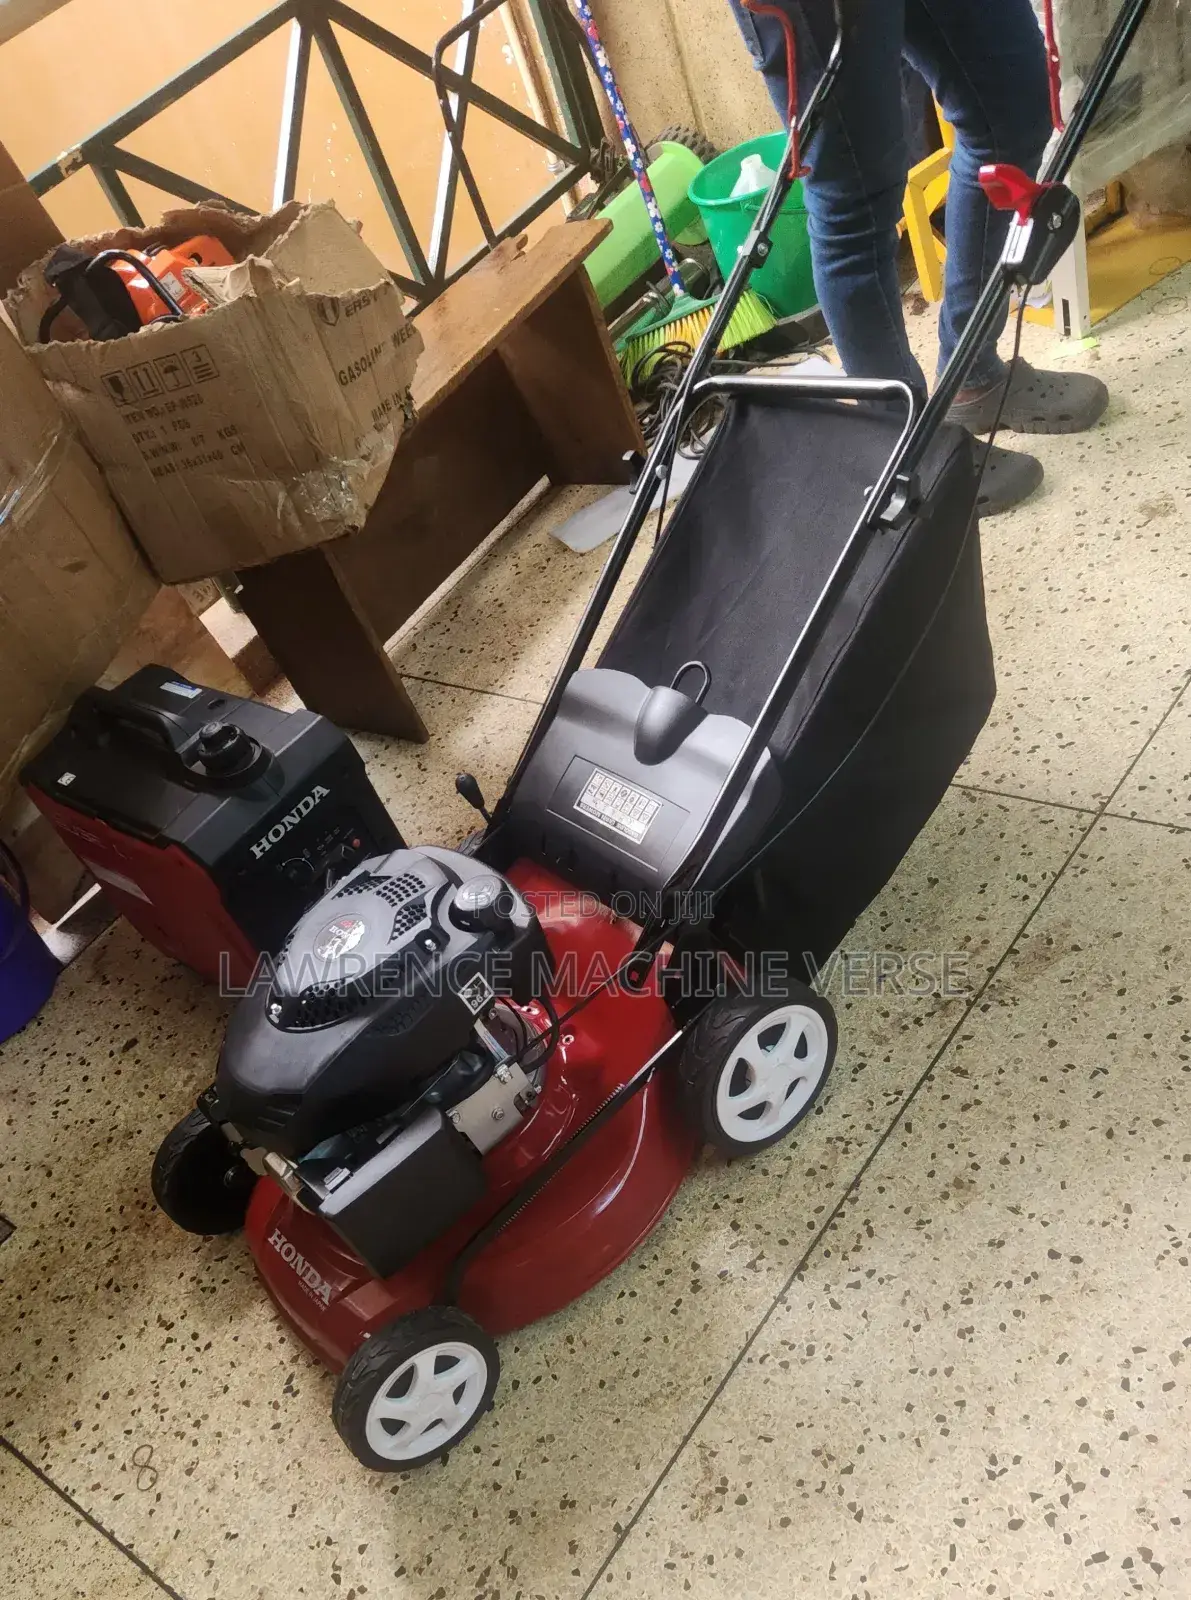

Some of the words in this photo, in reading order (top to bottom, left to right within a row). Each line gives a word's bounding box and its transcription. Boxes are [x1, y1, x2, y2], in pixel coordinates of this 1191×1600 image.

[249, 785, 330, 860] HONDA
[267, 1228, 332, 1306] HONDA
[132, 1444, 159, 1491] 8
